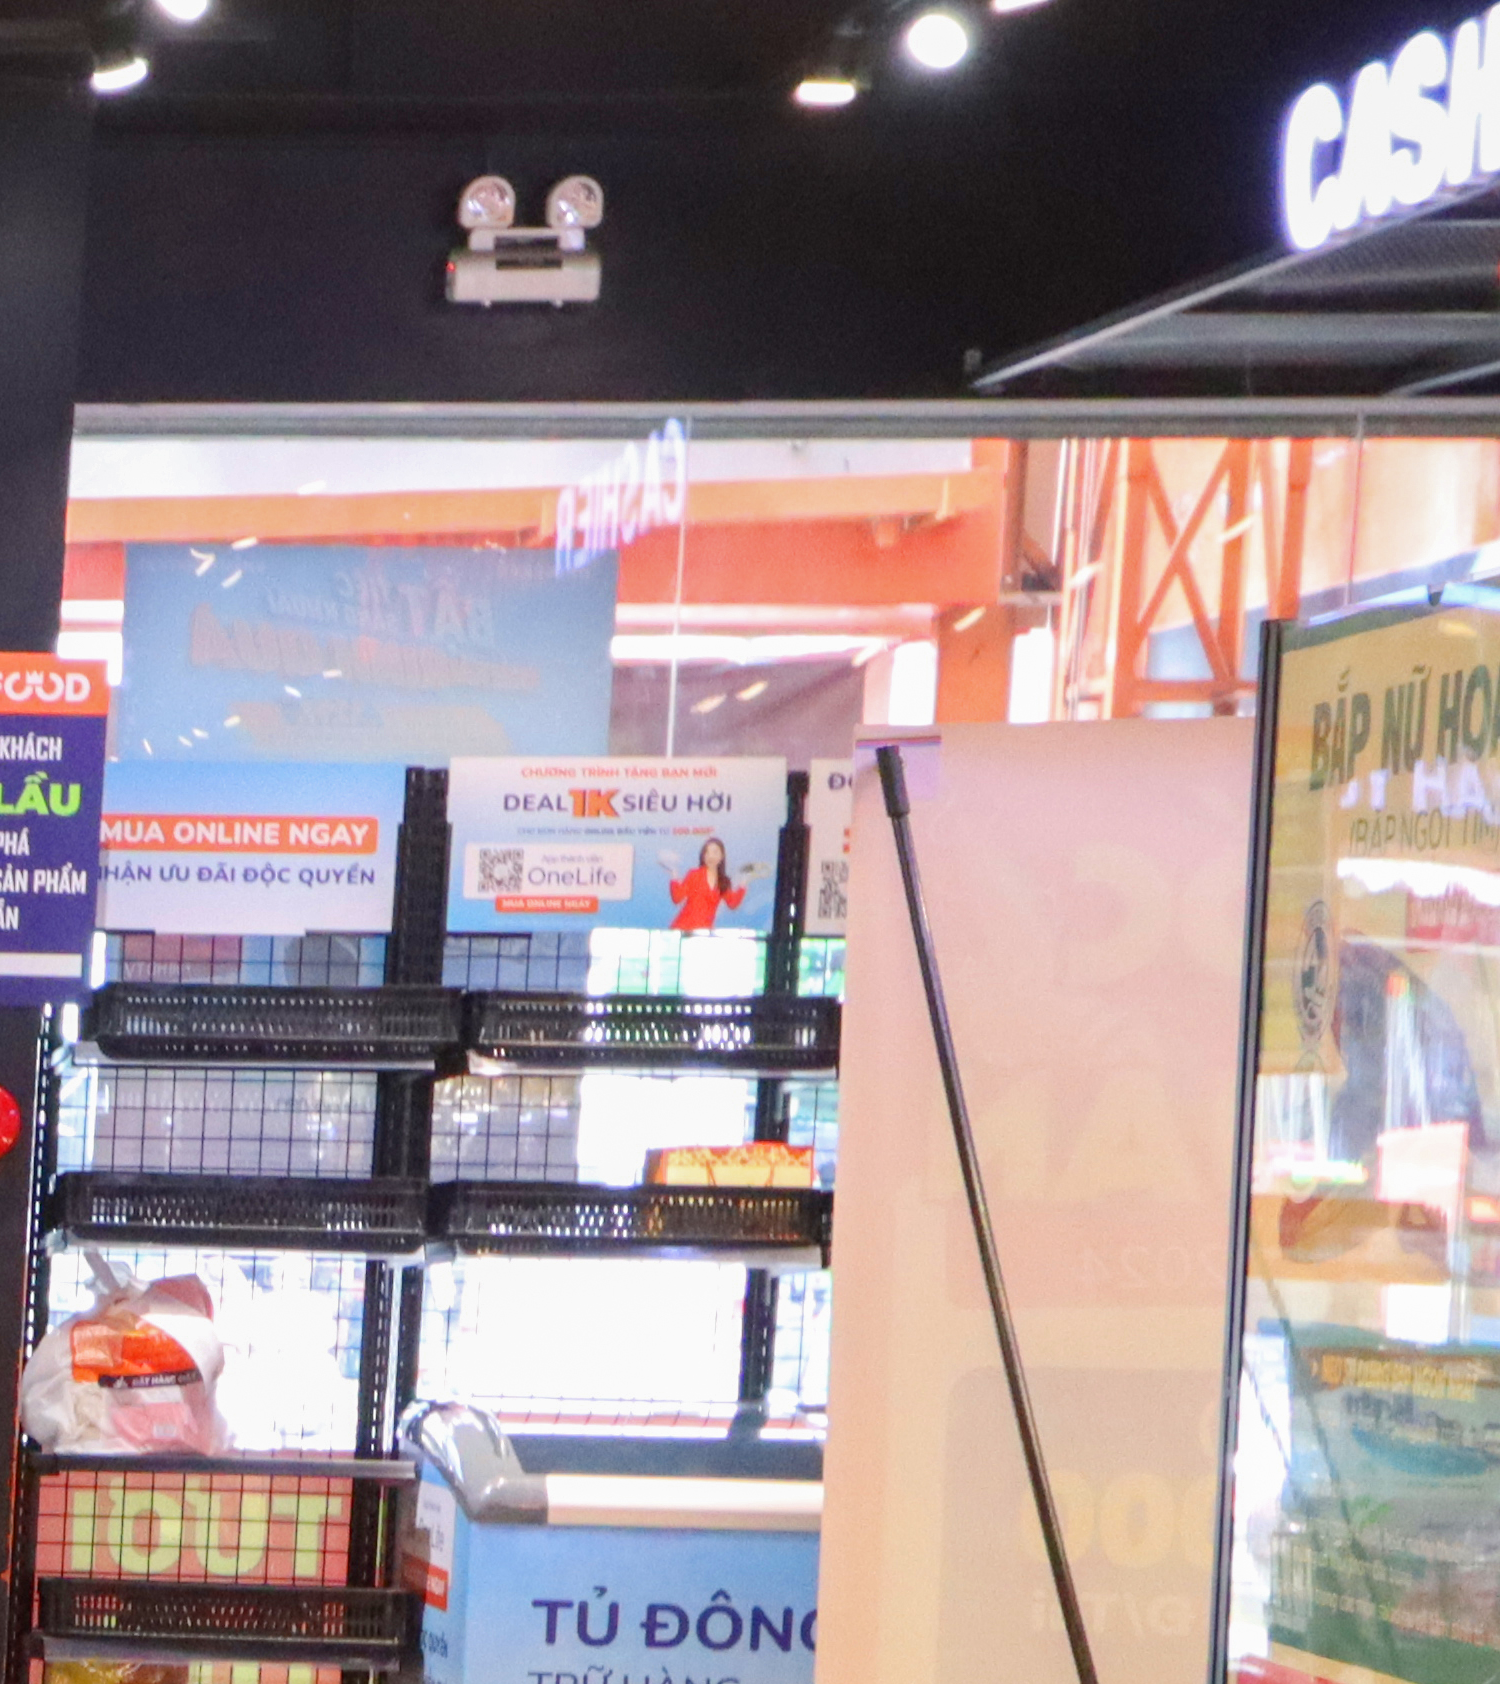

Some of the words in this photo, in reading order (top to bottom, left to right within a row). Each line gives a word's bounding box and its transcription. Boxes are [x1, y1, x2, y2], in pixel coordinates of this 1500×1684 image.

[1308, 669, 1372, 791] BẮP
[1380, 664, 1432, 776] NỮ
[502, 793, 570, 812] DEAL
[622, 787, 678, 813] SIÊU
[686, 790, 733, 813] HỜI
[100, 820, 165, 845] MUA
[173, 821, 281, 847] ONLINE
[288, 822, 370, 847] NGAY
[33, 861, 88, 895] PHẨM
[158, 863, 190, 882] ƯU
[196, 861, 236, 883] ĐÃI
[242, 861, 291, 888] ĐỘC
[298, 861, 376, 887] QUYỀN
[527, 864, 618, 887] OneLife
[531, 1585, 620, 1647] TỦ
